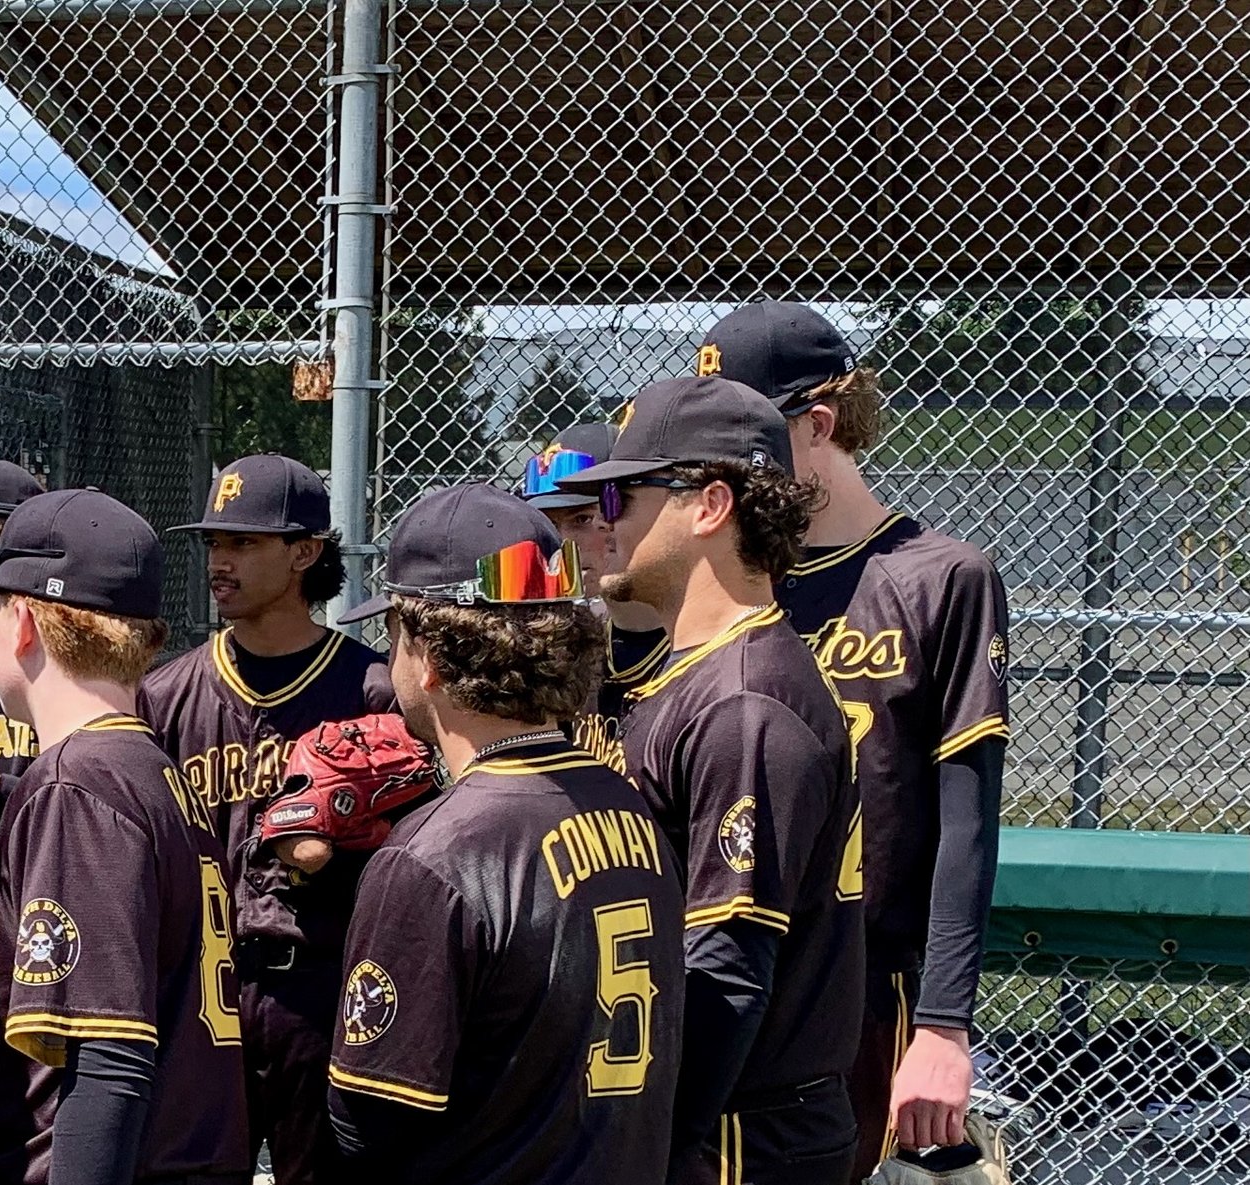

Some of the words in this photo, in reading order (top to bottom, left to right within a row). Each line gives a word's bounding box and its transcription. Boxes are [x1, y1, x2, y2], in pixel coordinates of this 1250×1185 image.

[184, 740, 296, 807] PIRA
[270, 806, 316, 824] Wilson
[542, 809, 662, 900] CONWAY
[43, 902, 77, 942] DELTA
[586, 898, 659, 1097] 5
